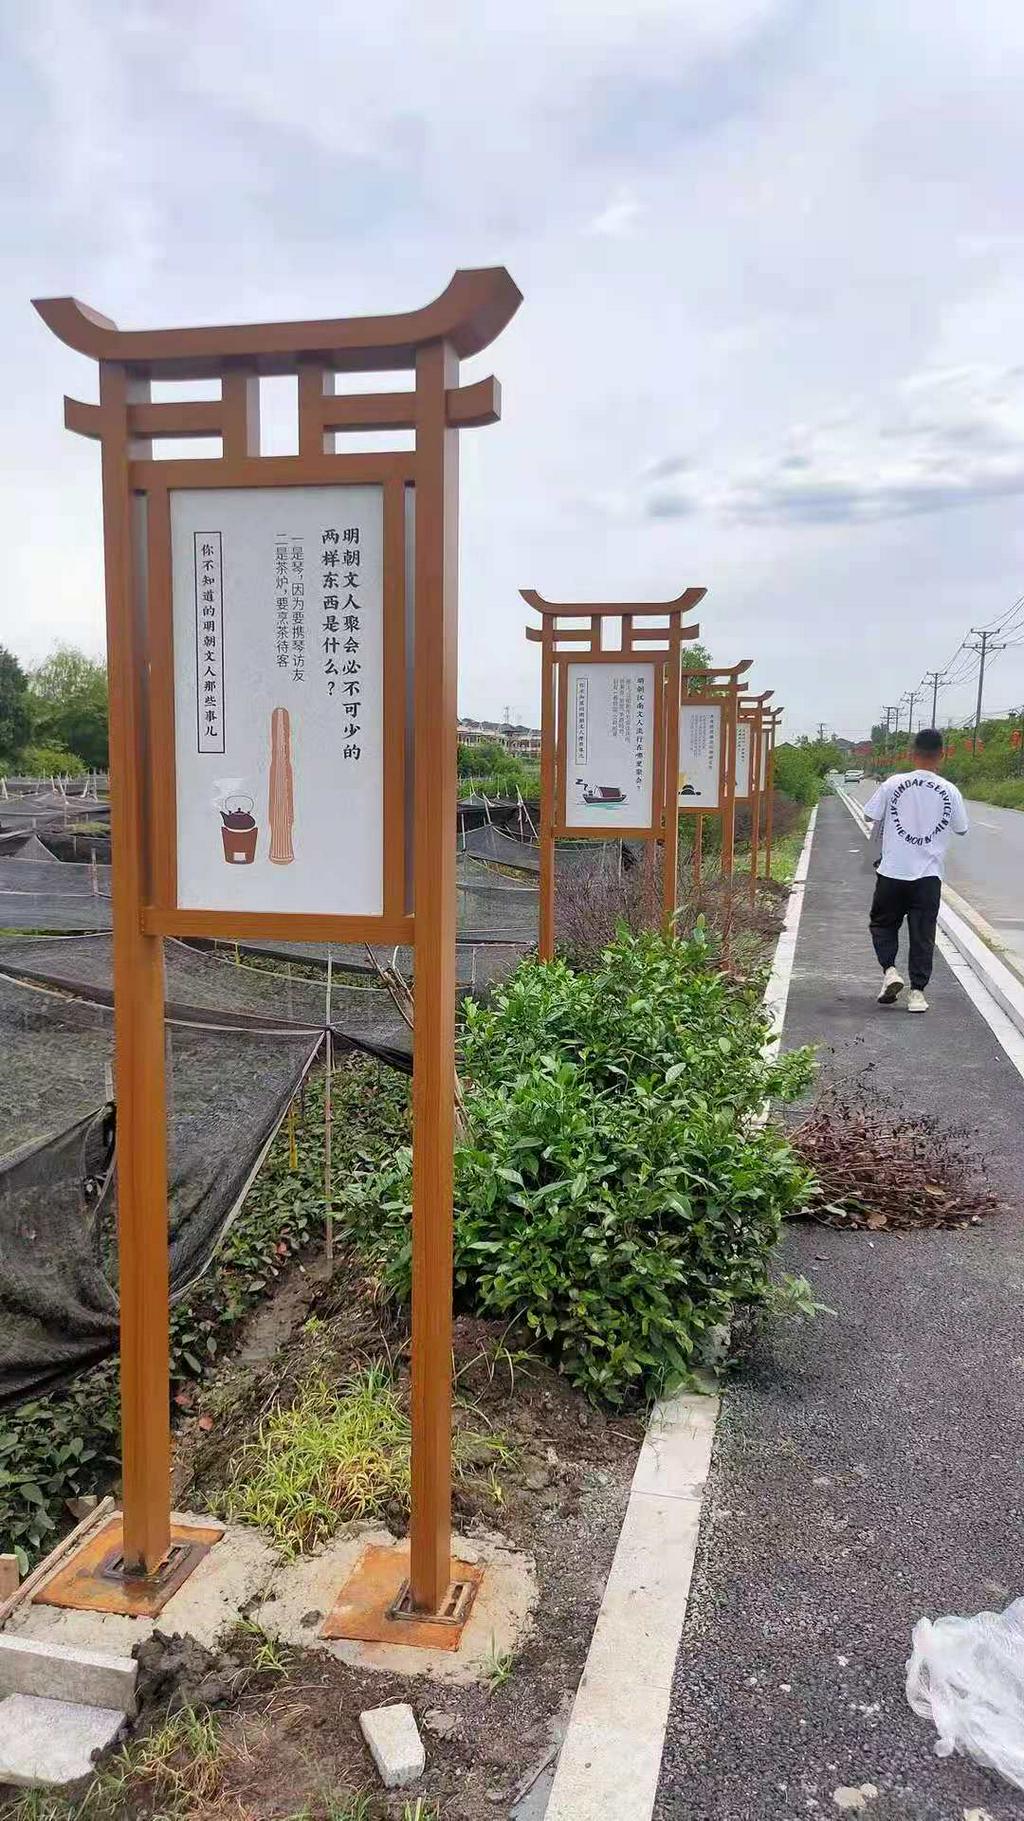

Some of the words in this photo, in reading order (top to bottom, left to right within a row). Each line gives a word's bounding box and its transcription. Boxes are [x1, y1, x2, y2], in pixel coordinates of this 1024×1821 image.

[200, 544, 218, 737] 你不知道的明朝文人那些事儿
[275, 534, 290, 667] 二是茶炉,要烹茶待客
[290, 537, 305, 682] 一是琴,因为要携琴访友
[322, 529, 340, 696] 两样东西是什么?
[342, 528, 361, 760] 明朝文人聚会必不可少的
[892, 778, 926, 805] SUNDAY
[926, 781, 952, 819] SERVICE
